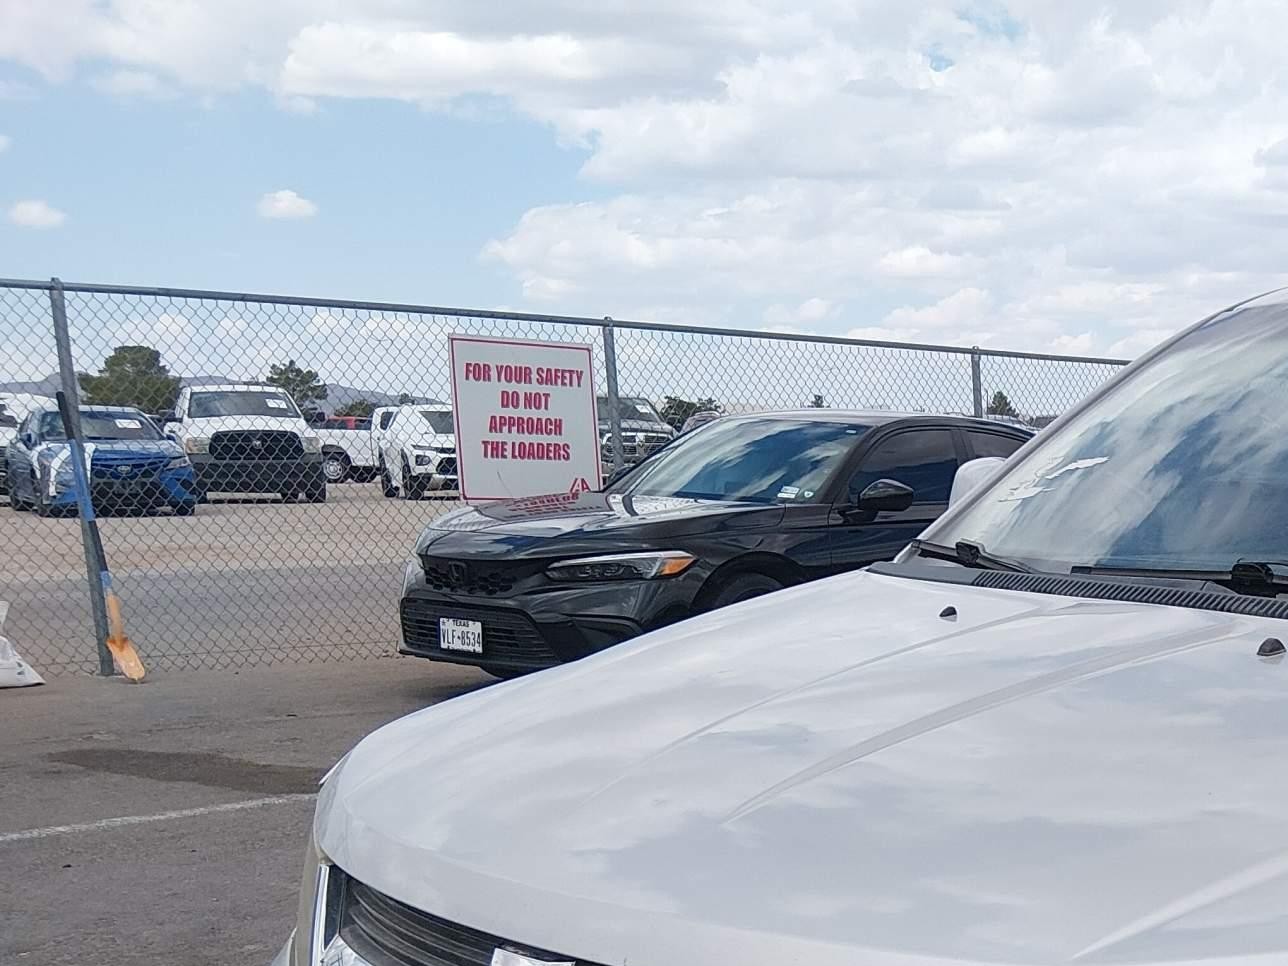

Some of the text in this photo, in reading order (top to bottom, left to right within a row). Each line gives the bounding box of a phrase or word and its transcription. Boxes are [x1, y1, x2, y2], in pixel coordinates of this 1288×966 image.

[465, 362, 584, 388] FOR YOUR SAFETY
[500, 390, 551, 411] DO NOT
[488, 415, 563, 436] APPROACH
[481, 440, 571, 461] THE LOADERS
